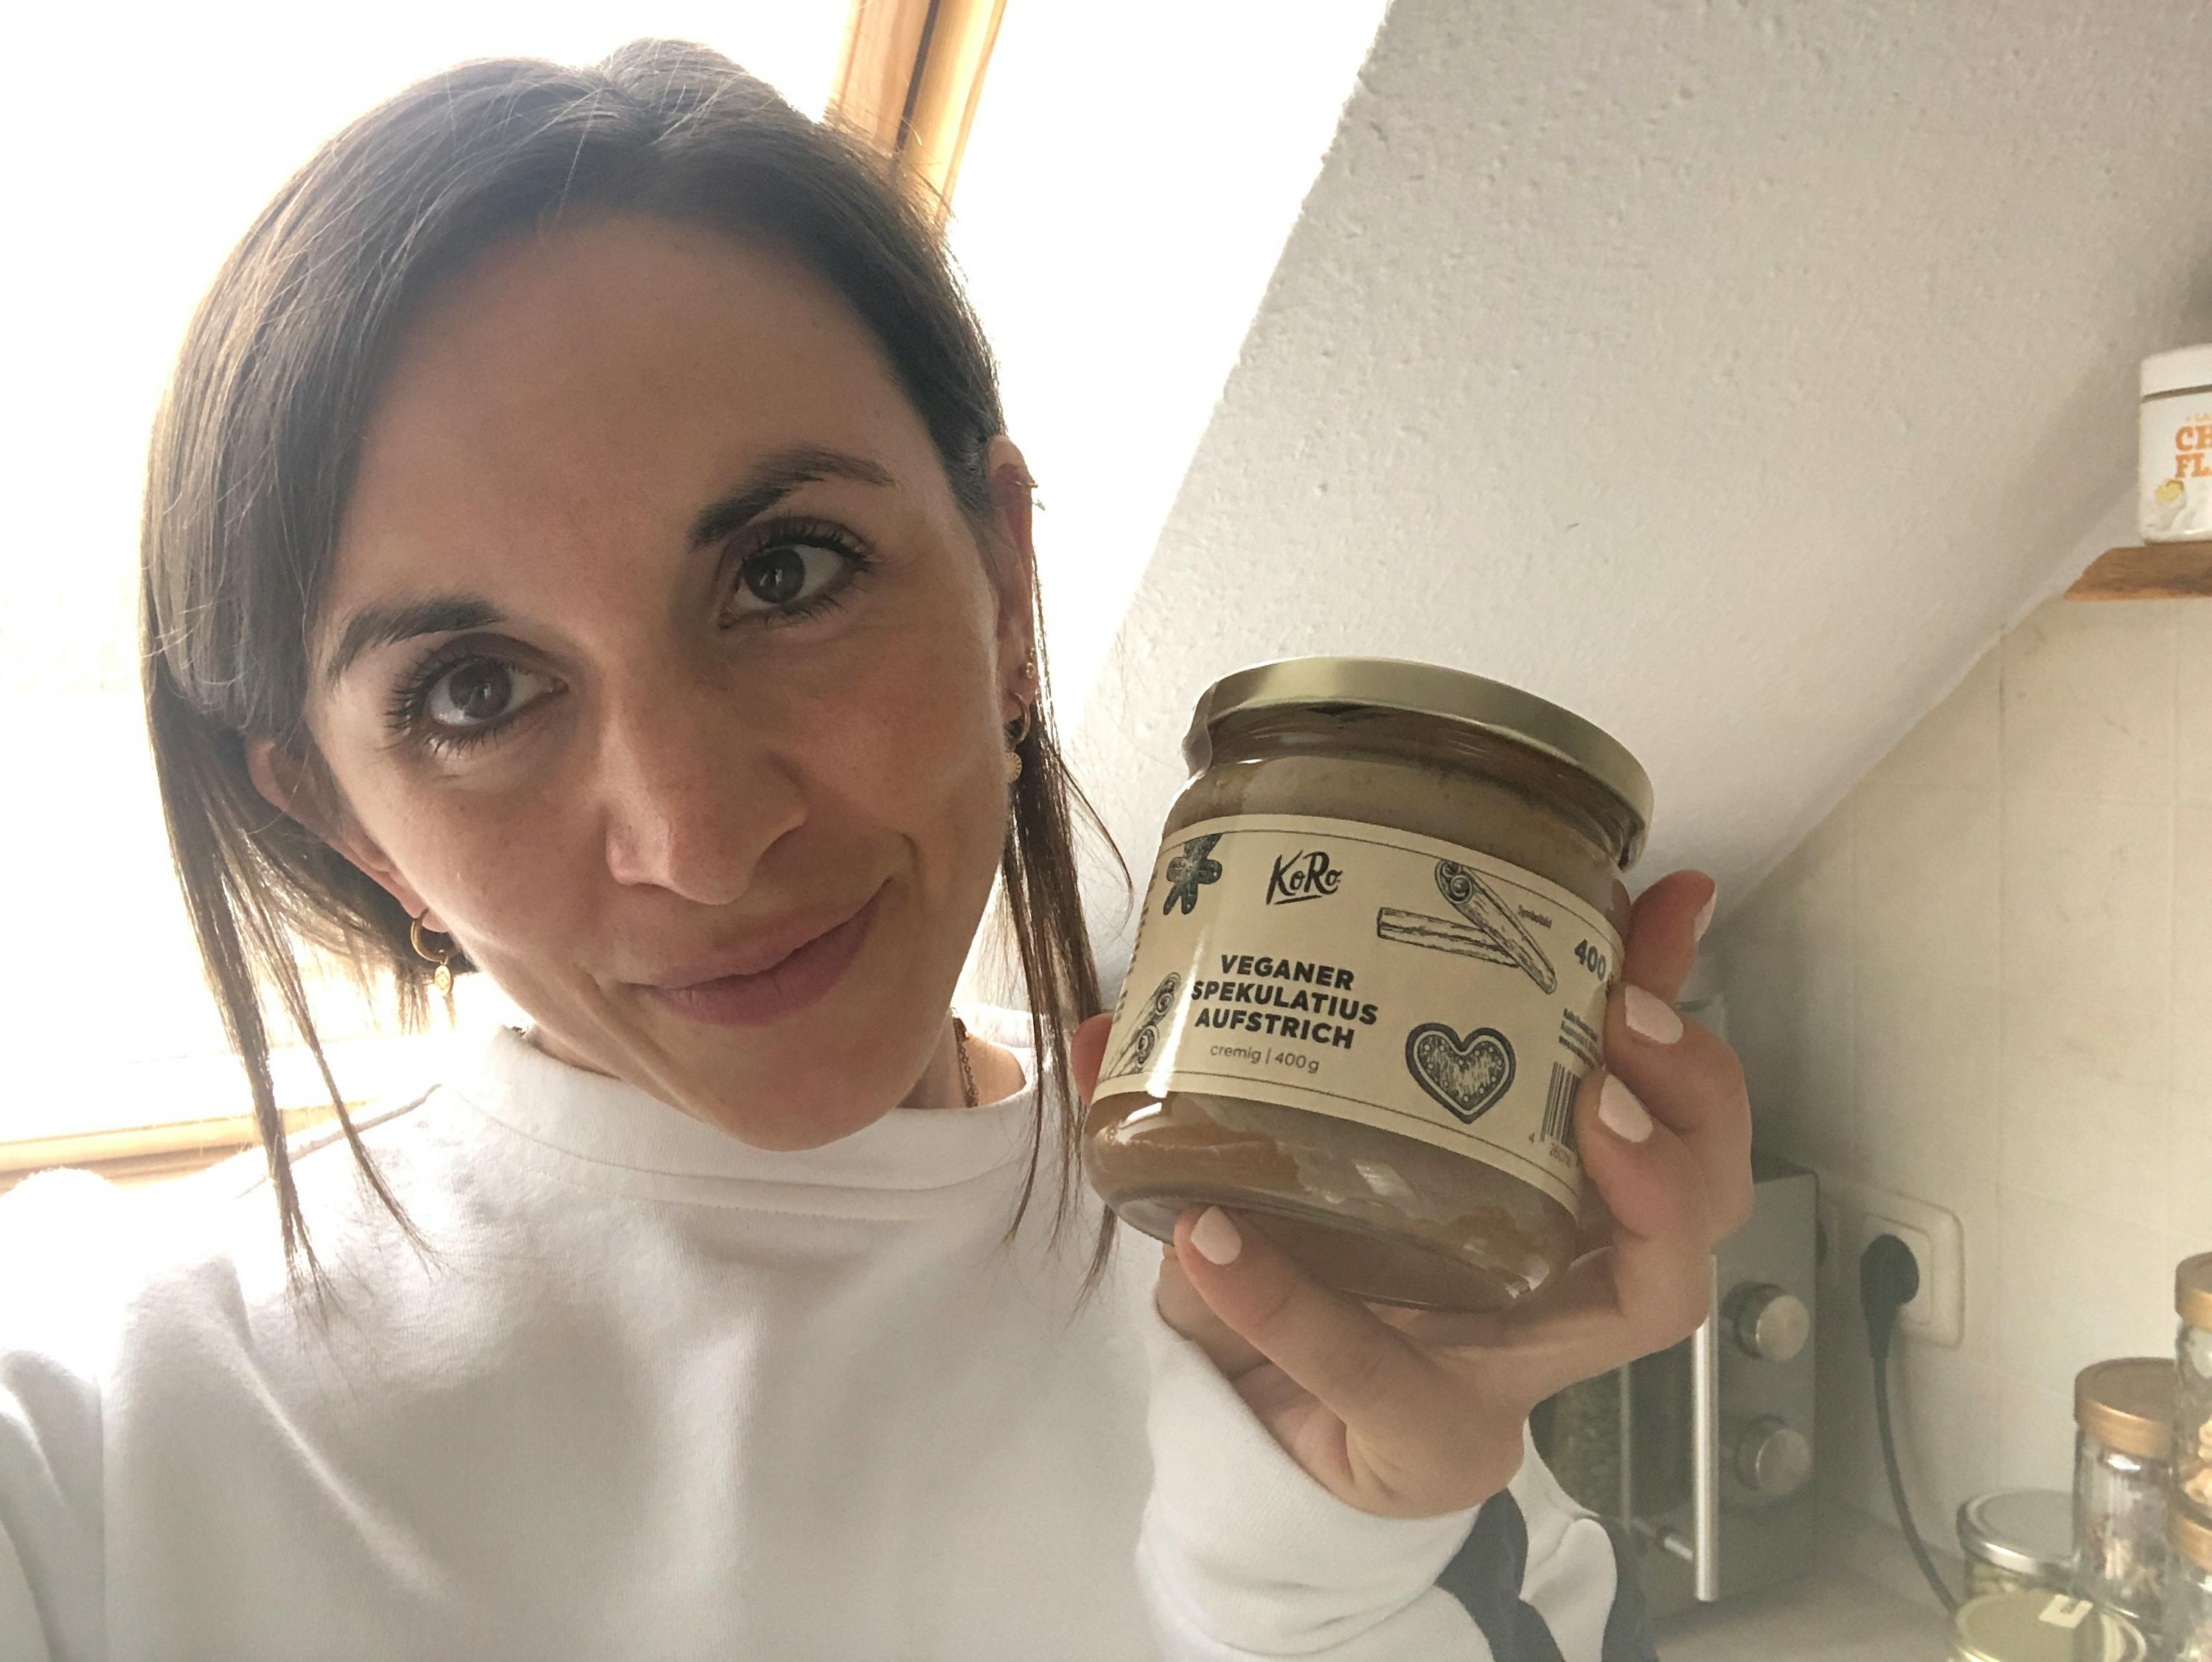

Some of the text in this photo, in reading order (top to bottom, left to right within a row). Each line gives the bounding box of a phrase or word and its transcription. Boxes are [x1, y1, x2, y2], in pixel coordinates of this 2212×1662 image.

[1266, 849, 1343, 905] KoRo
[1221, 954, 1354, 990] VEGANER
[1191, 981, 1378, 1025] SPEKULATIUS
[1194, 1008, 1354, 1049] AUFSTRICH
[1210, 1045, 1262, 1065] cremig
